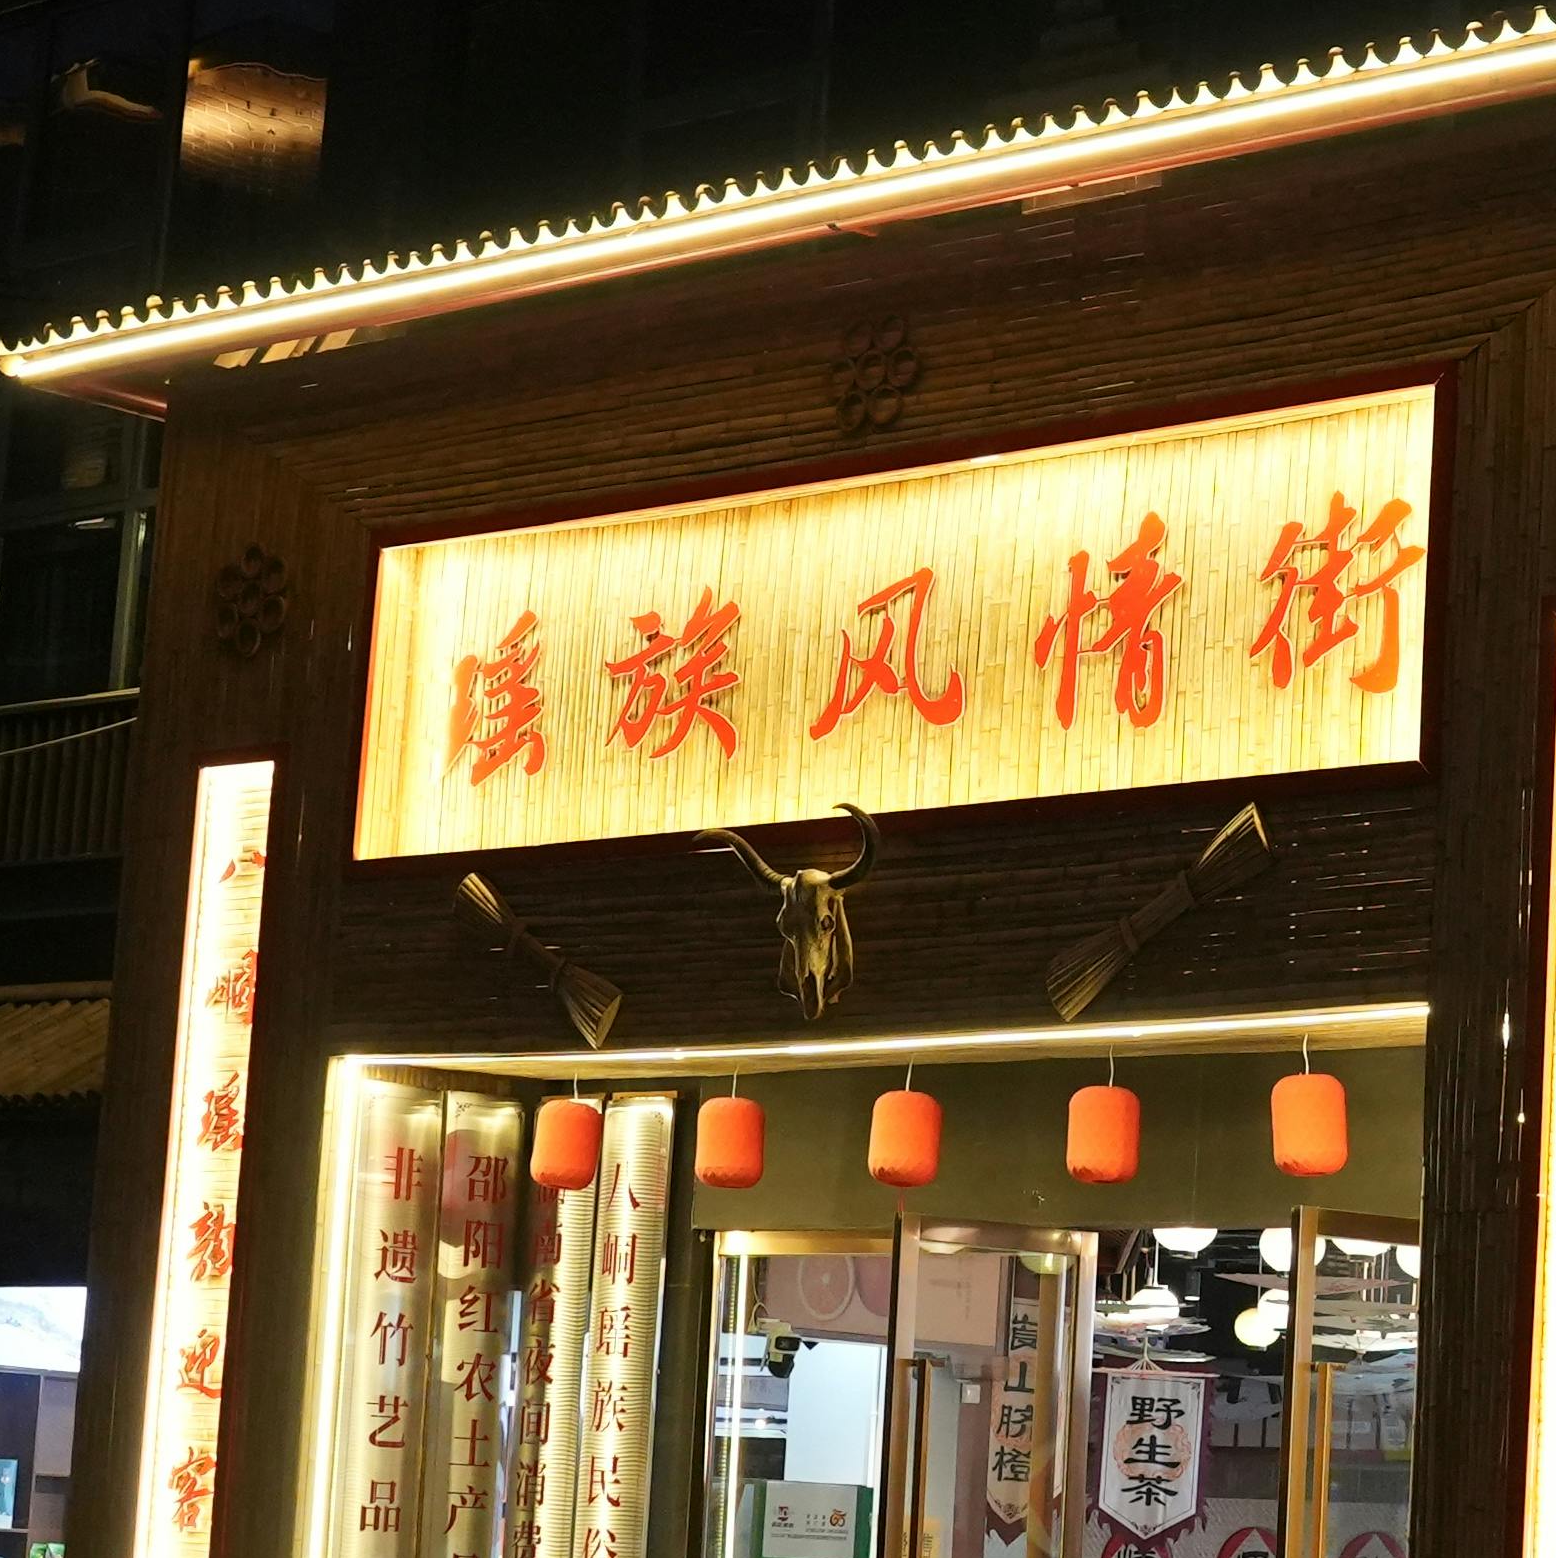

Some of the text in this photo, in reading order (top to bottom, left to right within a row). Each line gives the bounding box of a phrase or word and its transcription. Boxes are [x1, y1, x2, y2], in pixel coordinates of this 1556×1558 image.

[439, 490, 1426, 786] 瑶族风情街
[1120, 1395, 1185, 1507] 野生茶
